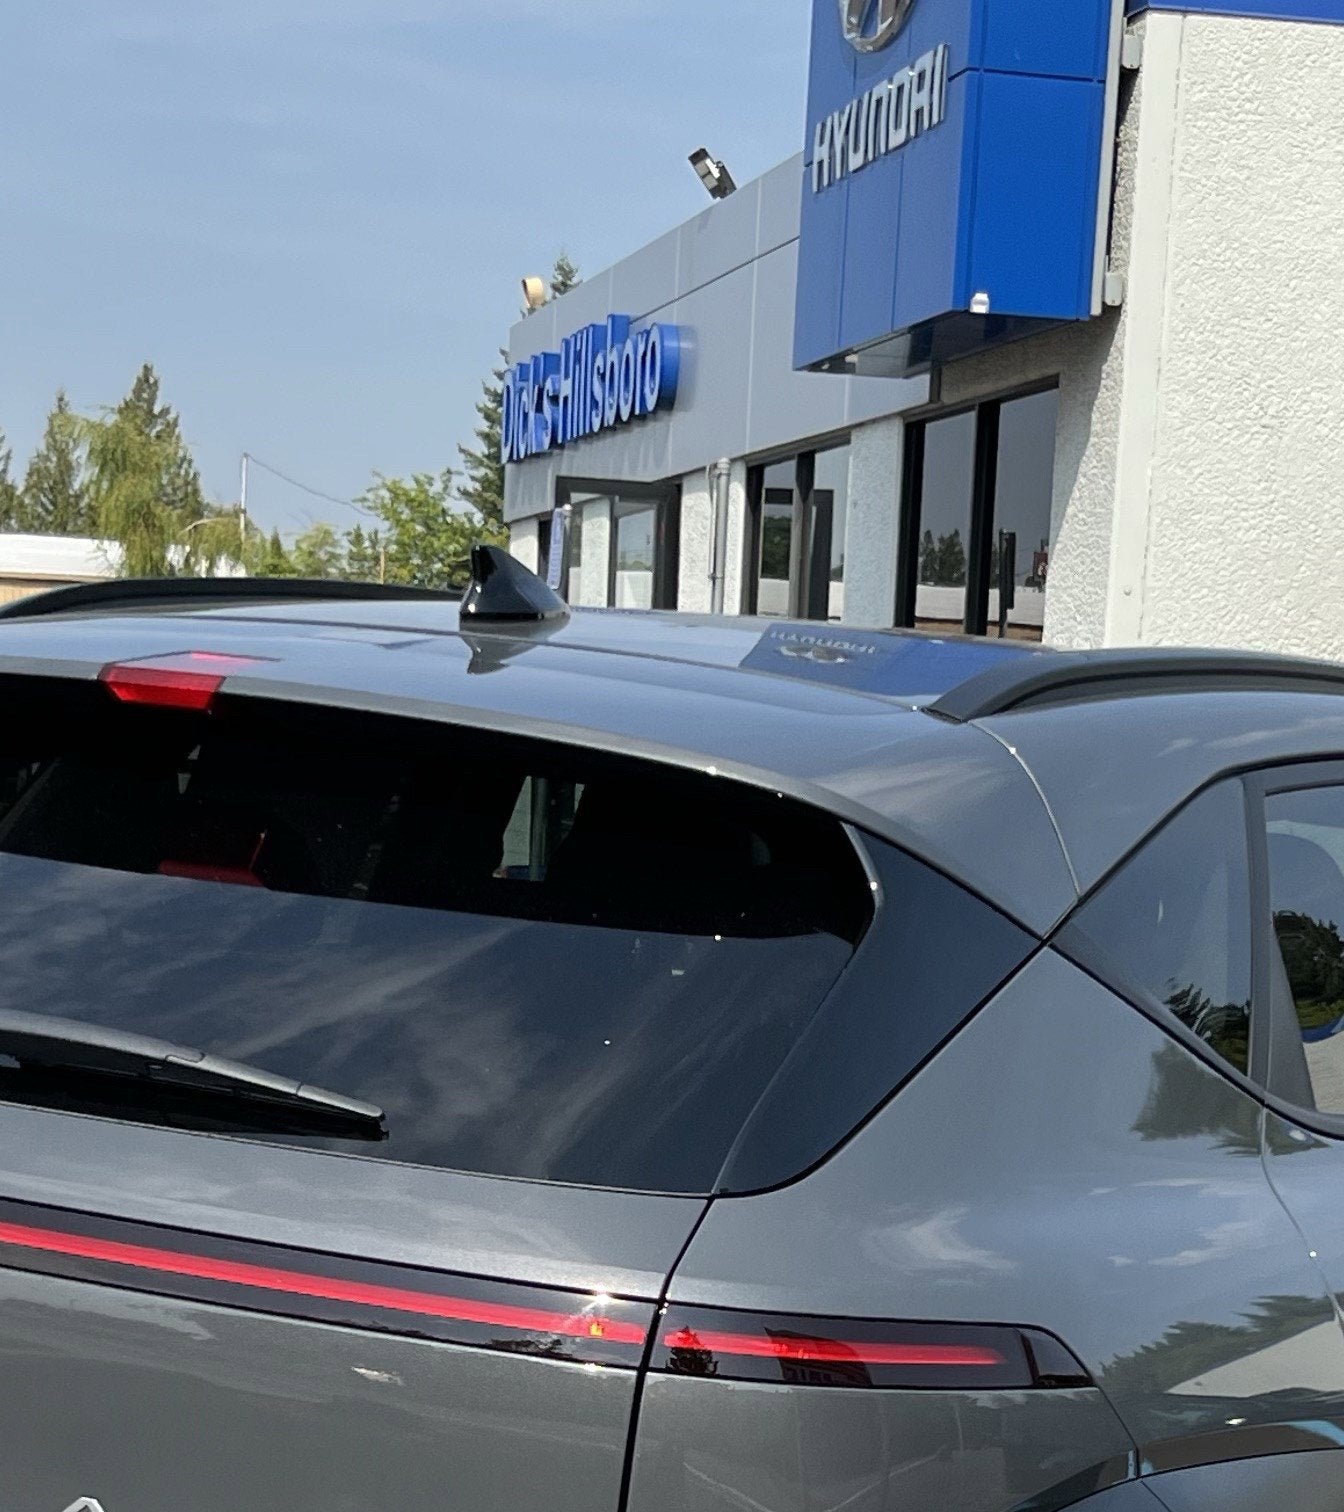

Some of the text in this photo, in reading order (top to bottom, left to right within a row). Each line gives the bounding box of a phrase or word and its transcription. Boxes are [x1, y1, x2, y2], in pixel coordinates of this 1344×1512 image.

[812, 42, 946, 195] HYUNDAI
[500, 313, 664, 464] Dick's Hillsboro
